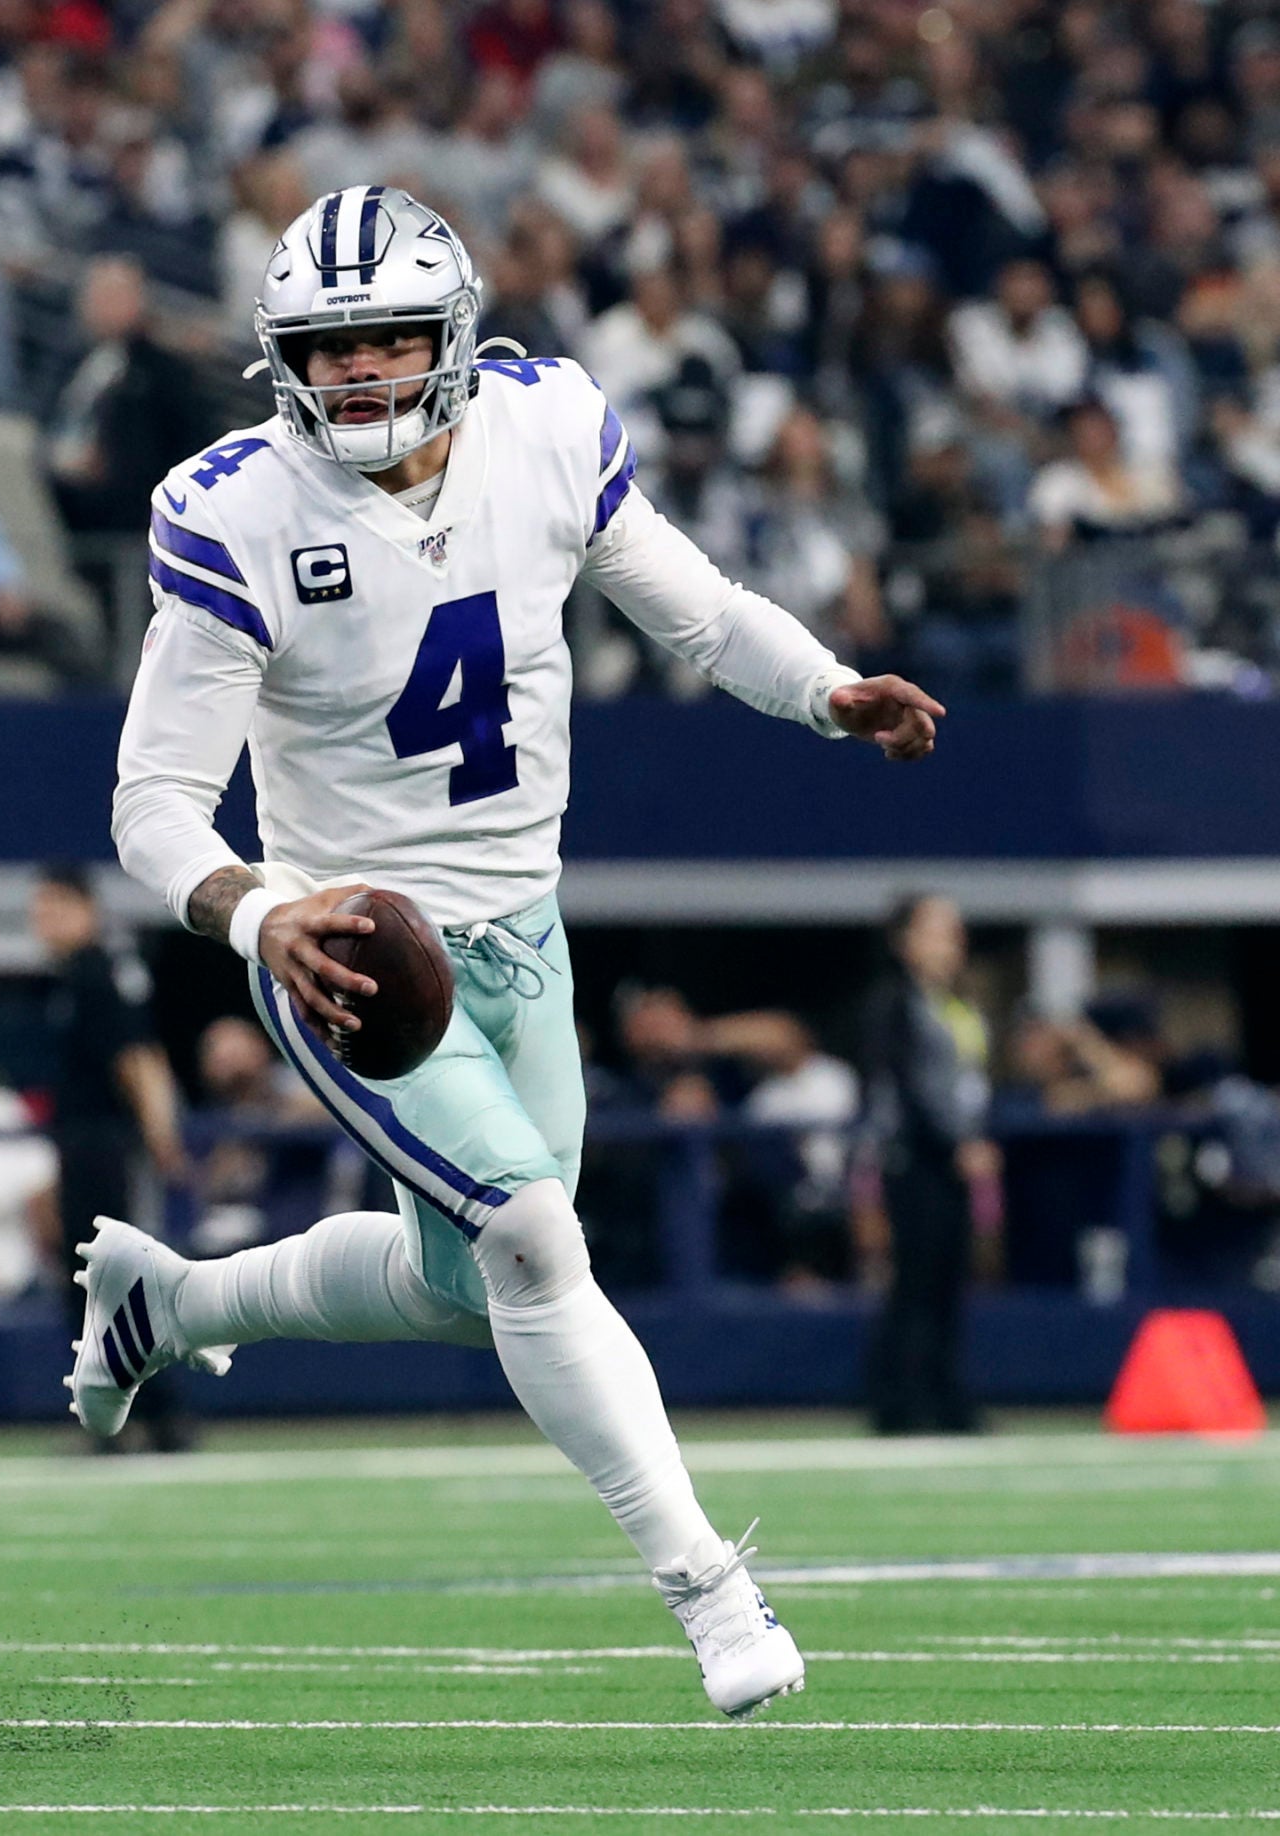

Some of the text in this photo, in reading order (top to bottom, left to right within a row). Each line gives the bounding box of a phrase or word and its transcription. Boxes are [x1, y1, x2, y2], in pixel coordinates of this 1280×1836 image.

[326, 293, 371, 305] COWBOYS
[189, 437, 271, 490] 4
[296, 548, 347, 589] C
[385, 590, 519, 807] 4
